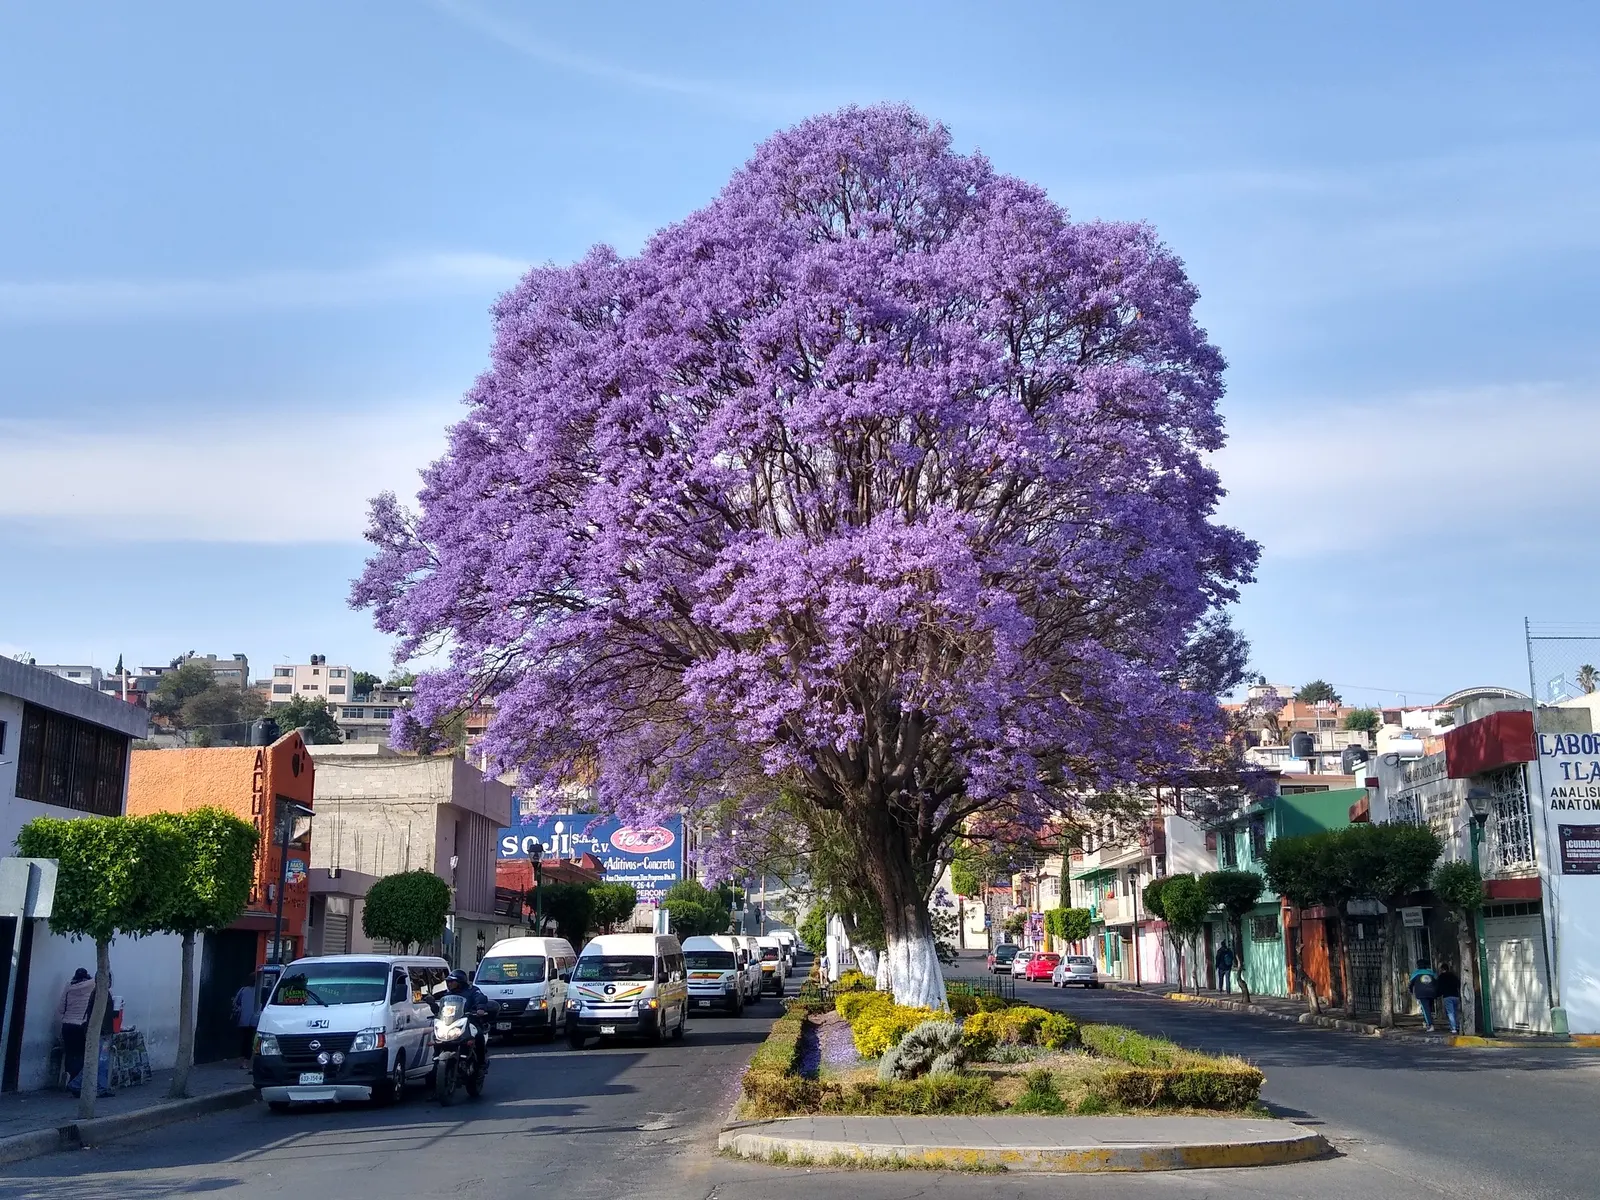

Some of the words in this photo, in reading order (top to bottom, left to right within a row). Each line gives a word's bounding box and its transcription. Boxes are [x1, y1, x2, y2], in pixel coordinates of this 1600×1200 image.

[1551, 799, 1600, 810] ANATOM
[607, 857, 637, 870] Aditivos
[644, 857, 675, 870] Concreto
[604, 984, 616, 995] 6
